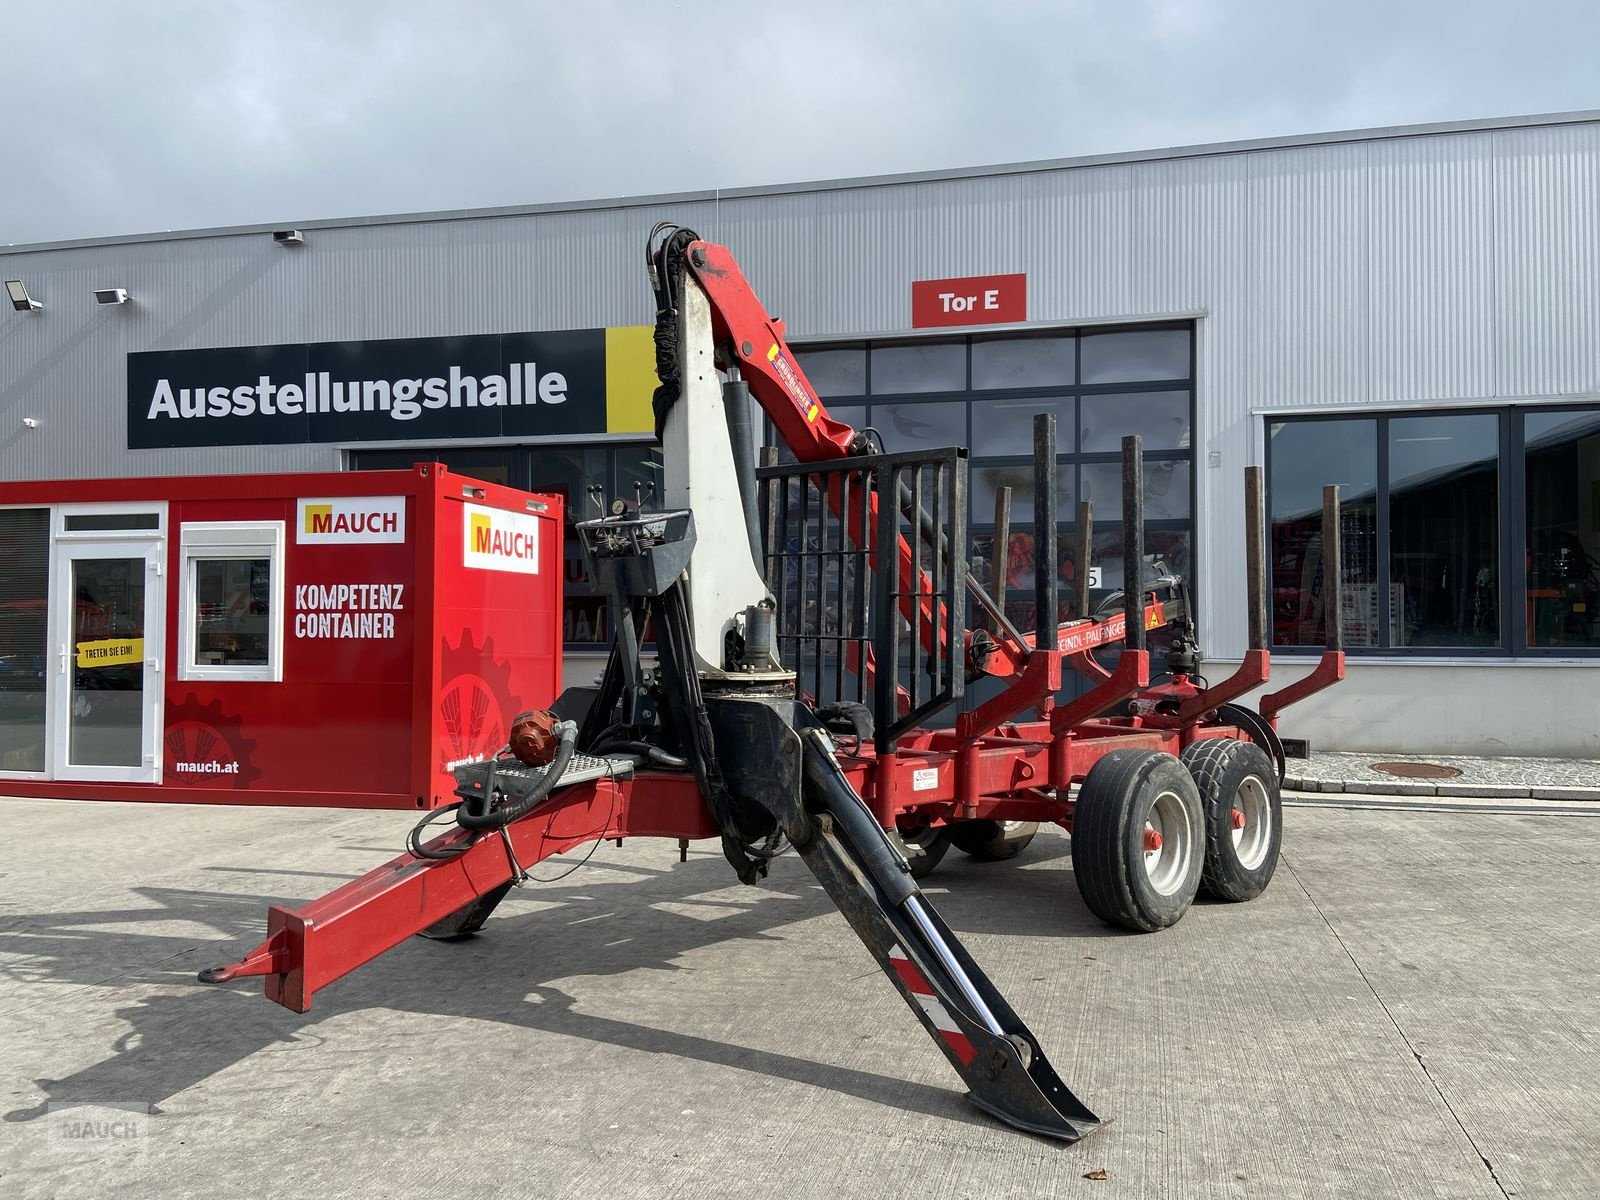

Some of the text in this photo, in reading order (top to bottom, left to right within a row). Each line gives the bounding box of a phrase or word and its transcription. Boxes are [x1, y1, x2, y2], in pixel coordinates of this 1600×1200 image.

[939, 290, 999, 313] Tor E
[147, 362, 568, 420] Ausstellungshalle
[312, 512, 397, 534] MAUCH
[476, 526, 534, 560] MAUCH
[295, 584, 404, 610] KOMPETENZ
[295, 613, 395, 638] CONTAINER
[85, 645, 133, 659] TRETEN SIE EIN!
[176, 760, 239, 773] mauch.at
